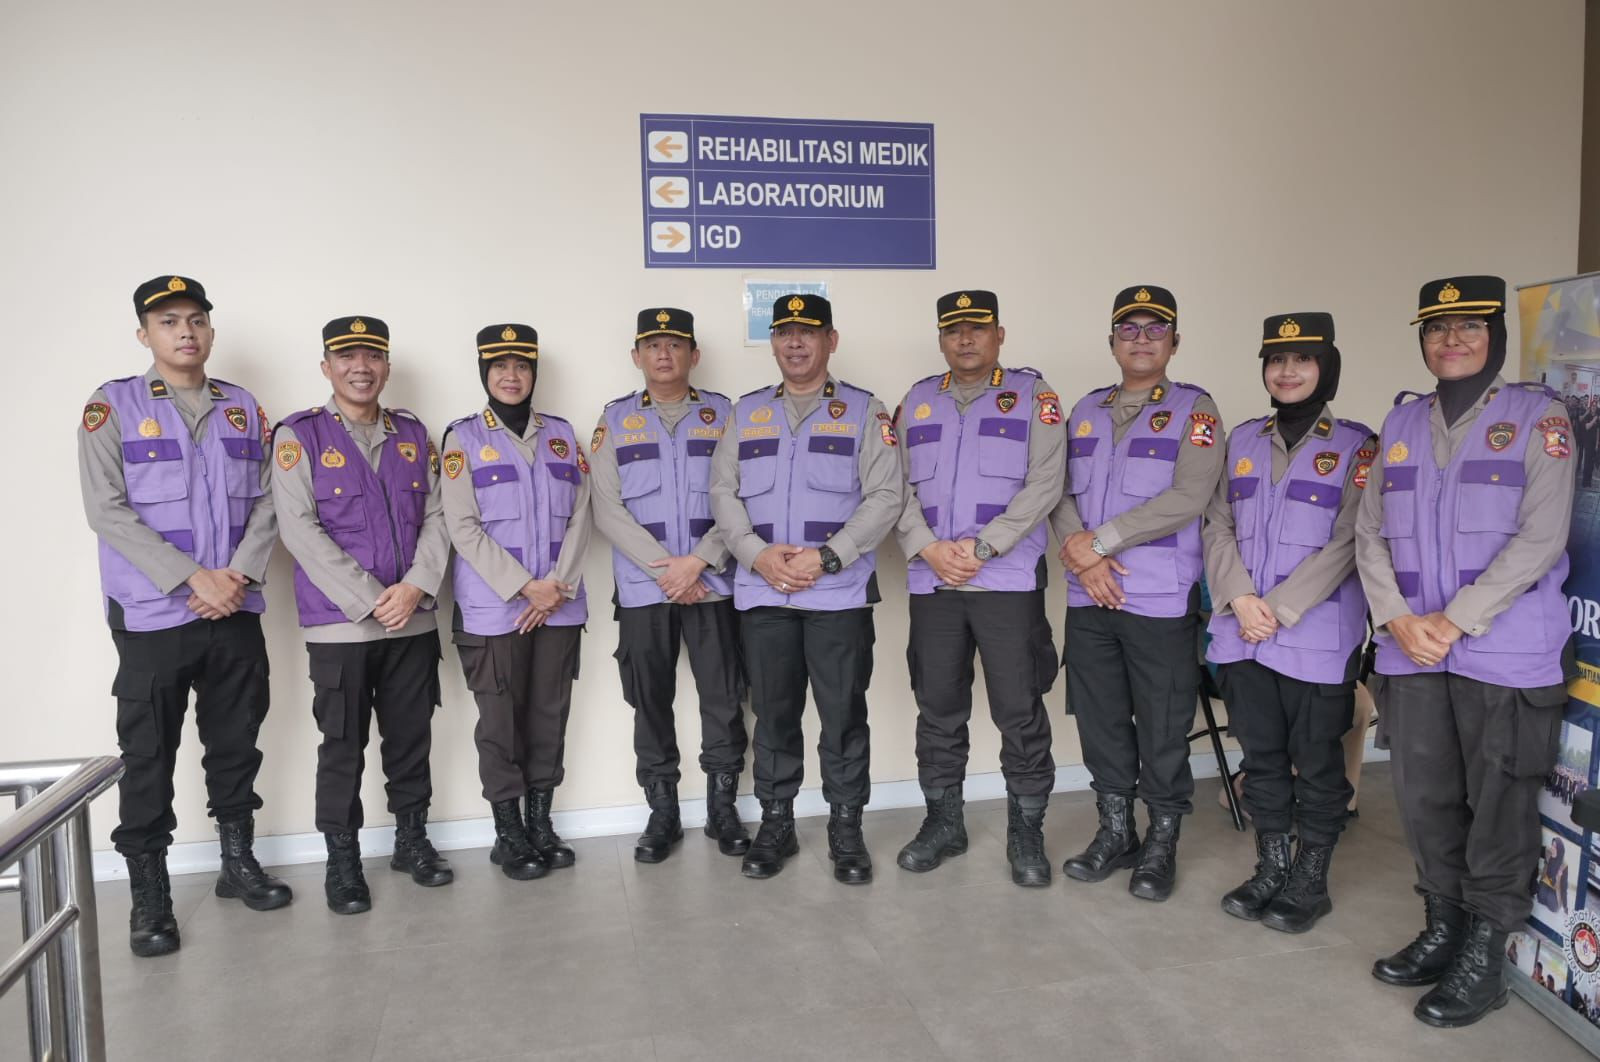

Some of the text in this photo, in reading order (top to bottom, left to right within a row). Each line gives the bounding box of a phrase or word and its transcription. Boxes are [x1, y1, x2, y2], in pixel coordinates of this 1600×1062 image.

[698, 136, 929, 166] REHABILITASI MEDIK
[698, 181, 884, 209] LABORATORIUM
[699, 224, 741, 249] IGD
